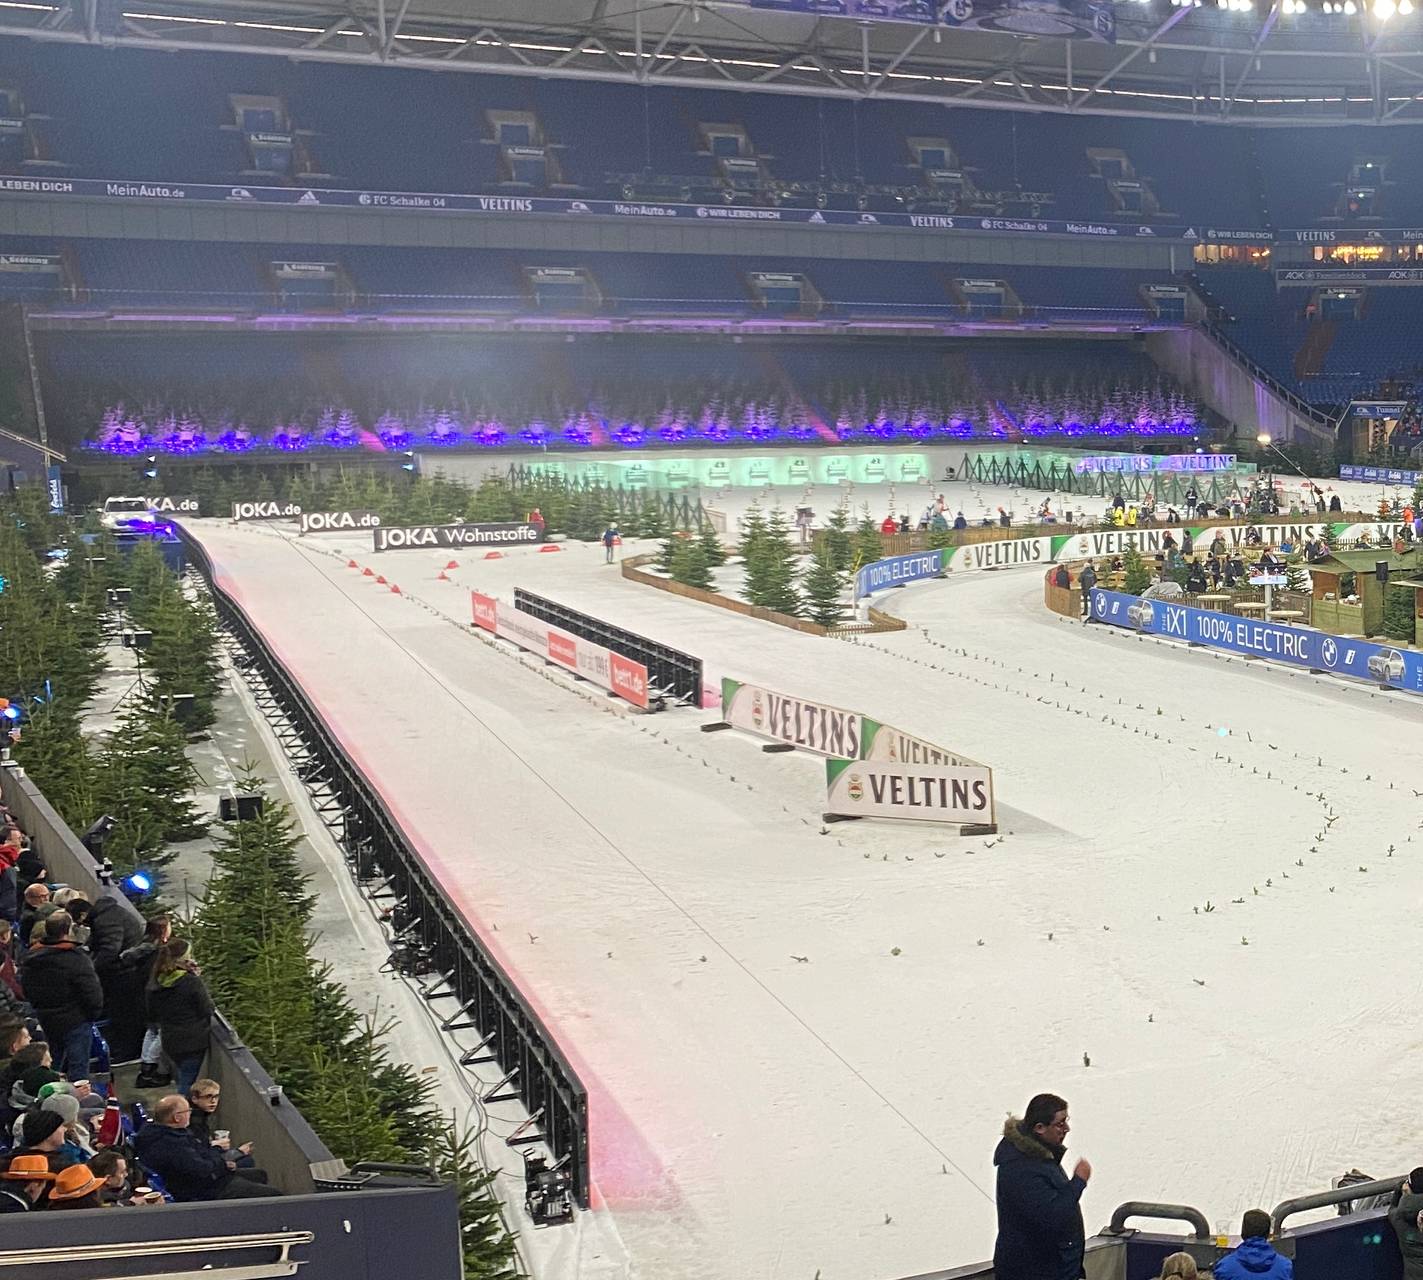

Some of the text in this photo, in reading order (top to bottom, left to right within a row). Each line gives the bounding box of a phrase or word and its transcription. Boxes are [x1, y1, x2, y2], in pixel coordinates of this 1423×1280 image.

[0, 180, 72, 192] LEBEN DICH
[106, 184, 185, 198] MeinAuto.de
[373, 196, 445, 207] FC Schalke 04
[480, 198, 533, 212] VELTINS
[614, 203, 677, 217] MeinAuto.de
[910, 215, 954, 228] VELTINS
[1296, 231, 1336, 241] VELTINS
[1285, 271, 1305, 280] AOK
[1388, 270, 1408, 279] AOK
[1181, 455, 1235, 469] VELTINS
[147, 498, 199, 511] KA.de
[235, 502, 301, 521] JOKA.de
[302, 512, 381, 532] JOKA.de
[380, 525, 537, 549] JOKA Wohnstoffe
[1093, 531, 1160, 554] VELTIN
[1231, 526, 1314, 547] VLTINS
[976, 540, 1040, 568] VELTINS
[893, 555, 938, 580] ELECTRIC
[1167, 606, 1187, 636] iX1
[1197, 615, 1308, 660] 100% ELECTRIC
[767, 693, 860, 759] VELTINS
[869, 774, 987, 811] VELTINS
